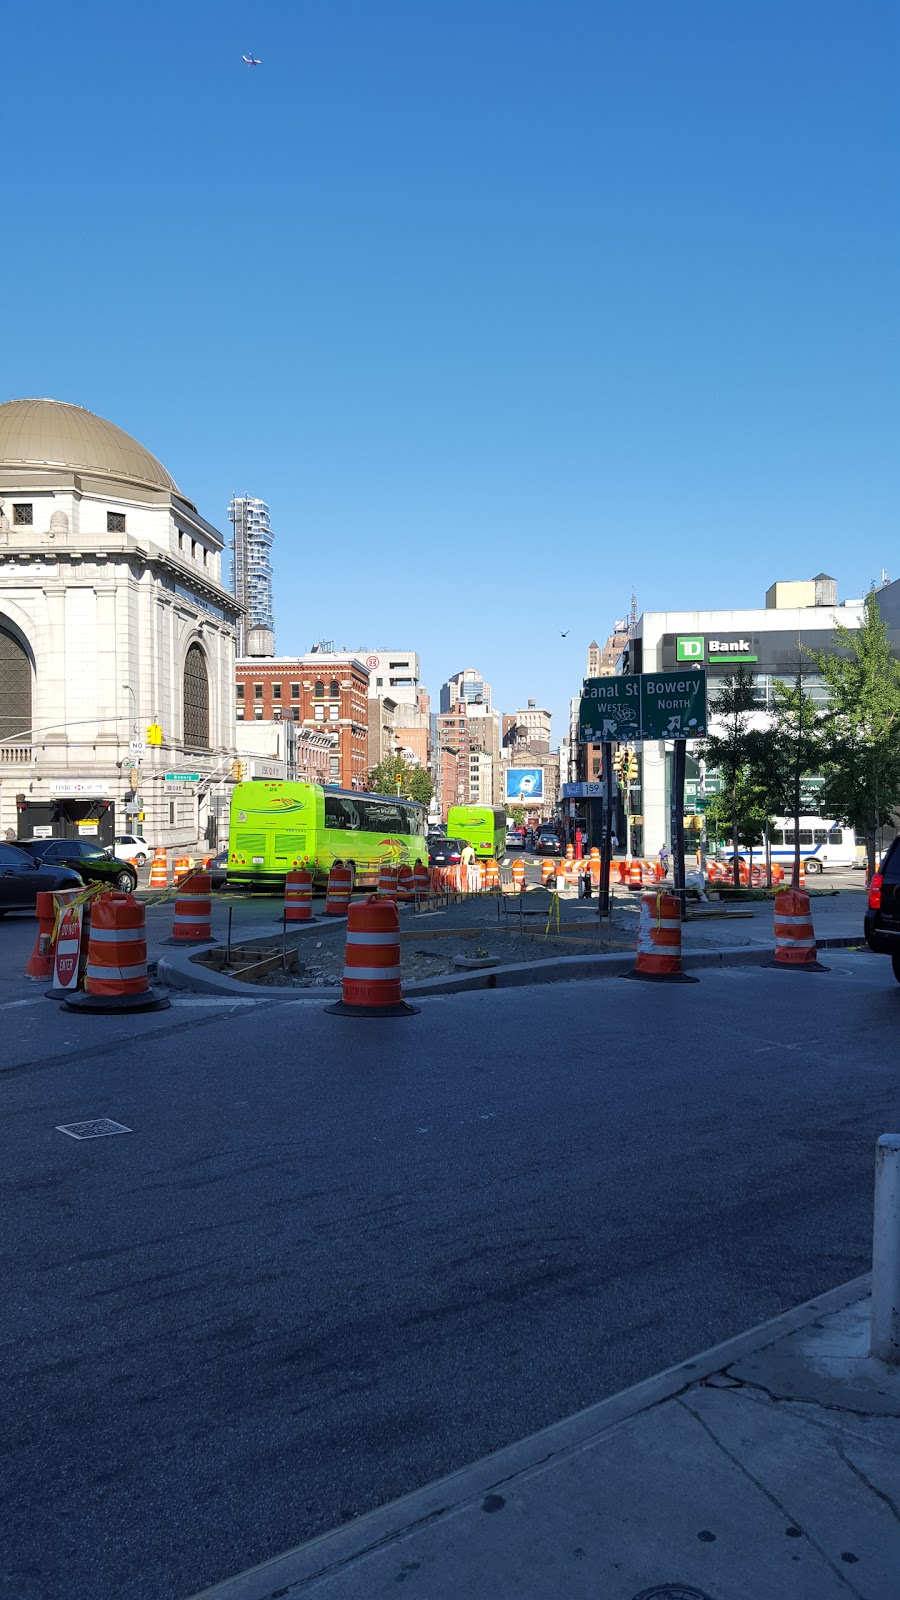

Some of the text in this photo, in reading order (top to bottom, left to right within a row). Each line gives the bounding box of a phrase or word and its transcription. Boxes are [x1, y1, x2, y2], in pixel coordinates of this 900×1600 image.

[680, 640, 750, 656] TD Bank
[582, 683, 638, 699] Canal St
[646, 679, 701, 695] Bowery
[657, 698, 691, 710] NORTH
[585, 784, 600, 794] 159
[61, 923, 78, 936] DO NOT
[59, 959, 73, 971] ENTER
